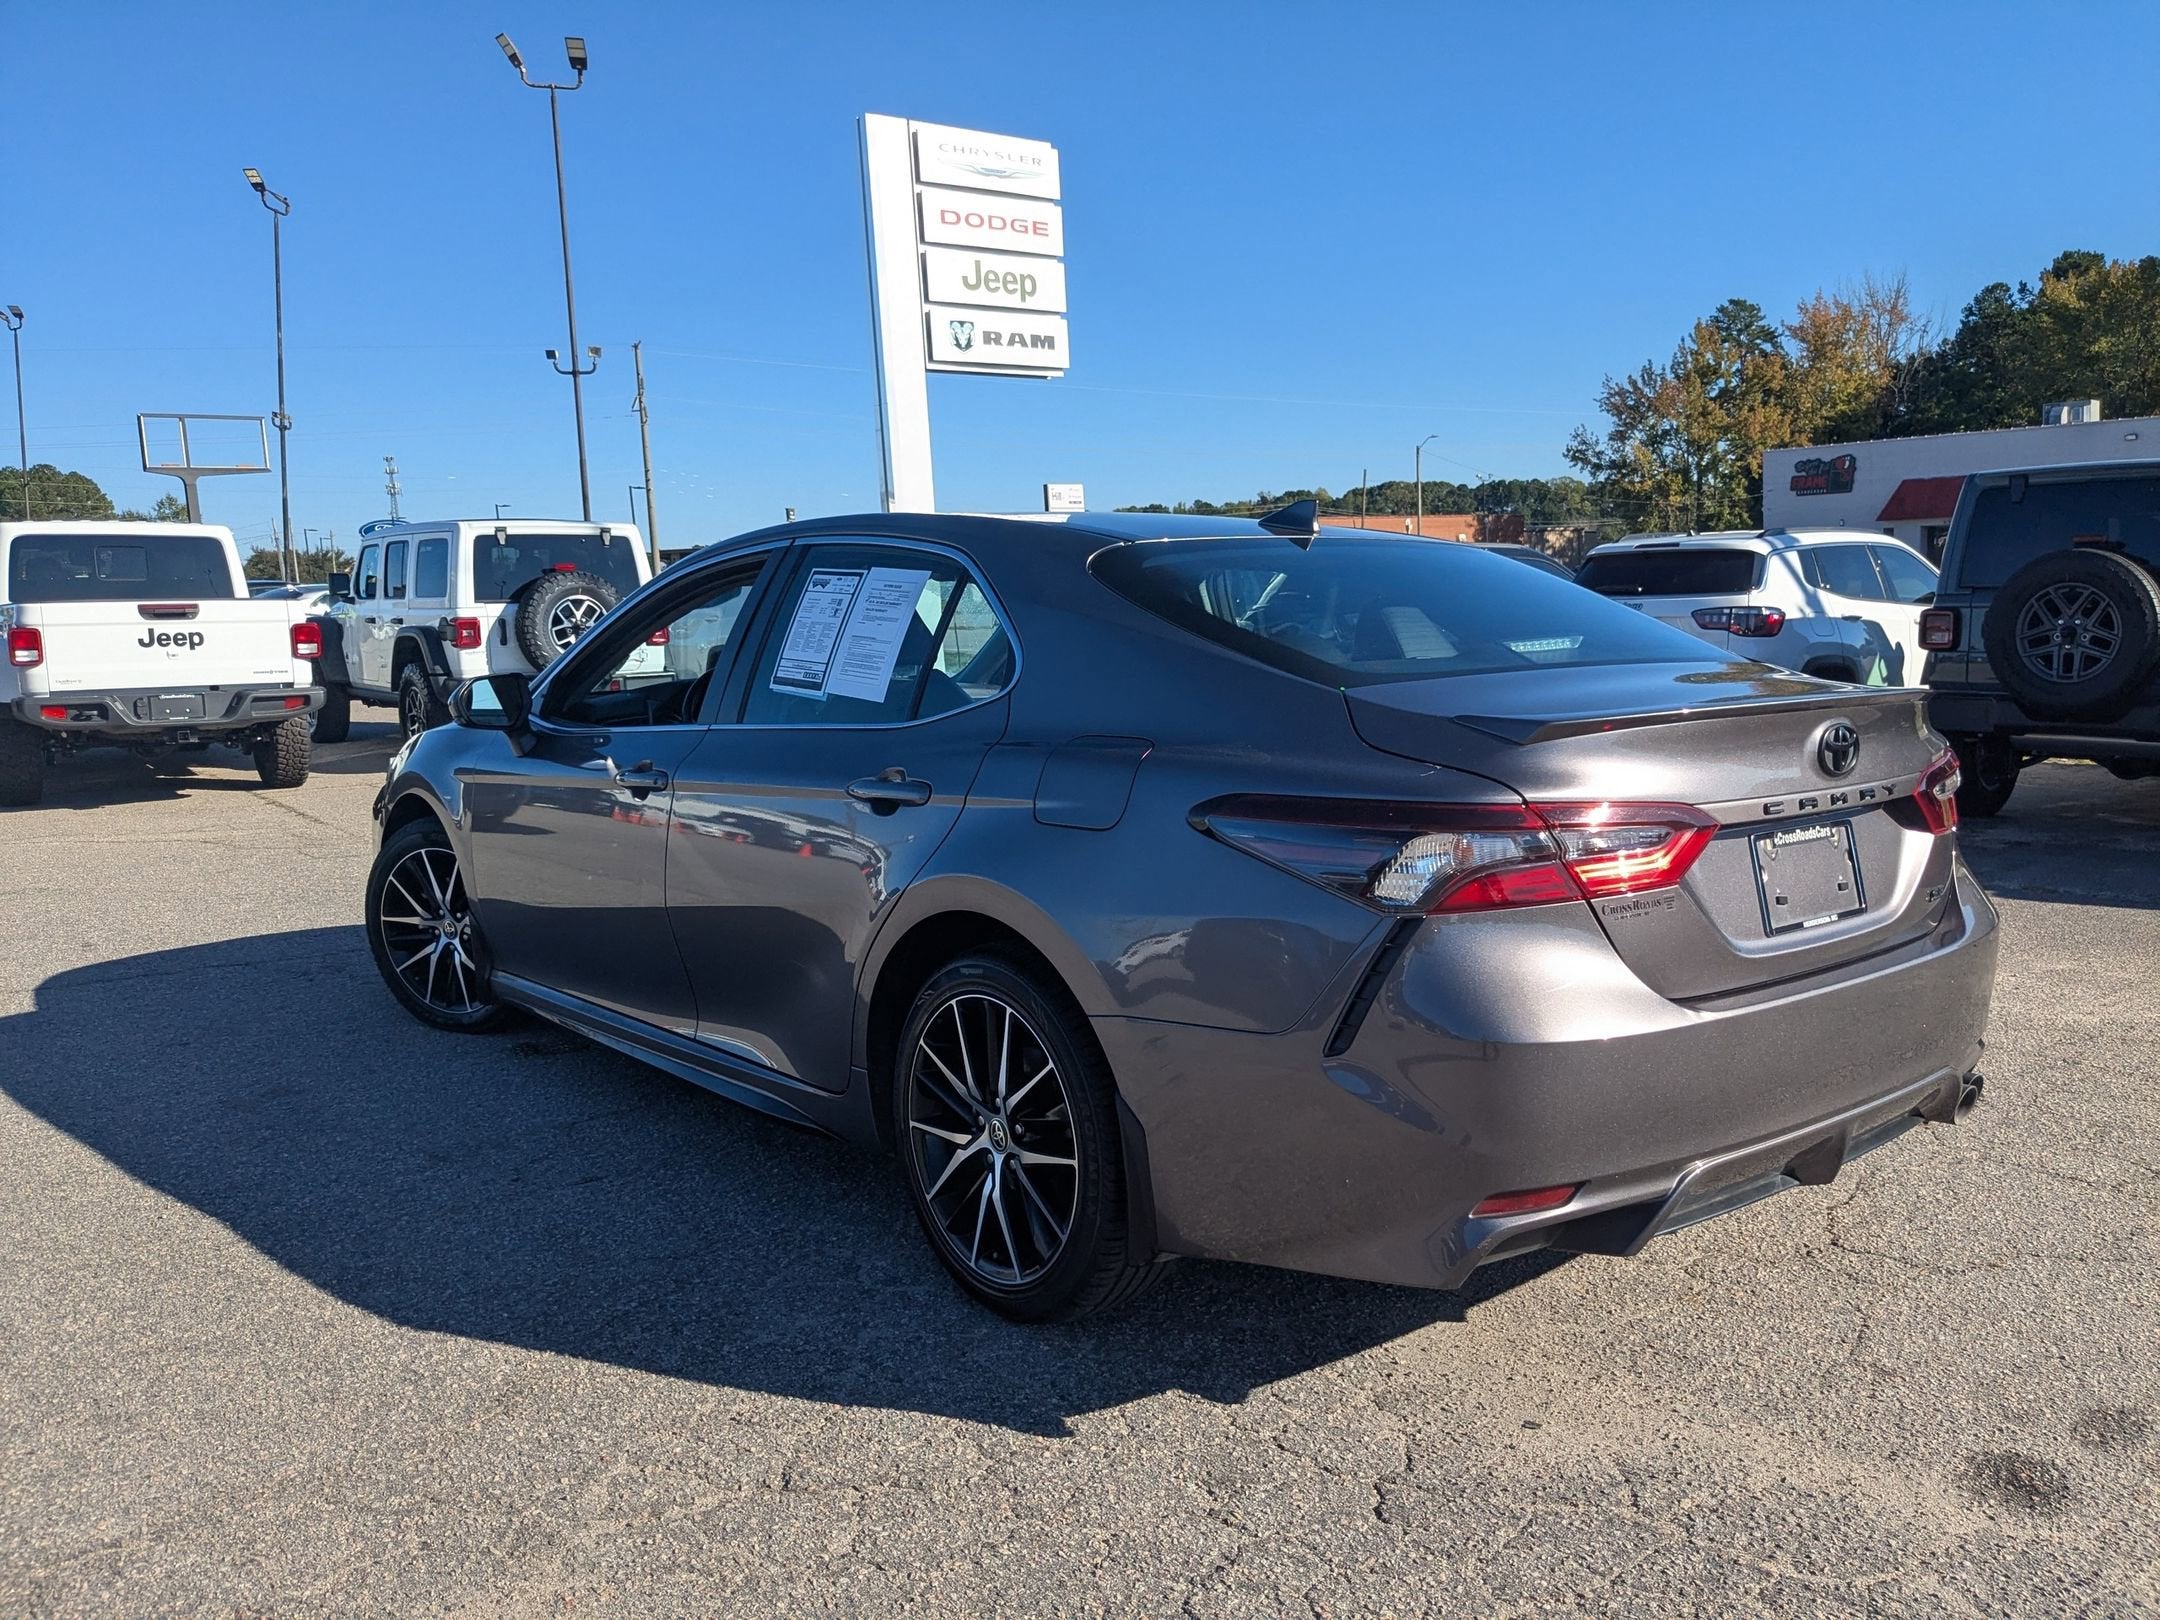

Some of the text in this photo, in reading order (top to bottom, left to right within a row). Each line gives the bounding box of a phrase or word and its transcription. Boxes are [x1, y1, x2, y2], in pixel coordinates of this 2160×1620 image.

[938, 143, 1042, 167] CHRYSLER
[940, 209, 1049, 237] DODGE
[962, 260, 1037, 302] Jeep
[982, 330, 1056, 350] RAM
[137, 628, 204, 650] Jeep
[1763, 783, 1897, 816] CAMRY
